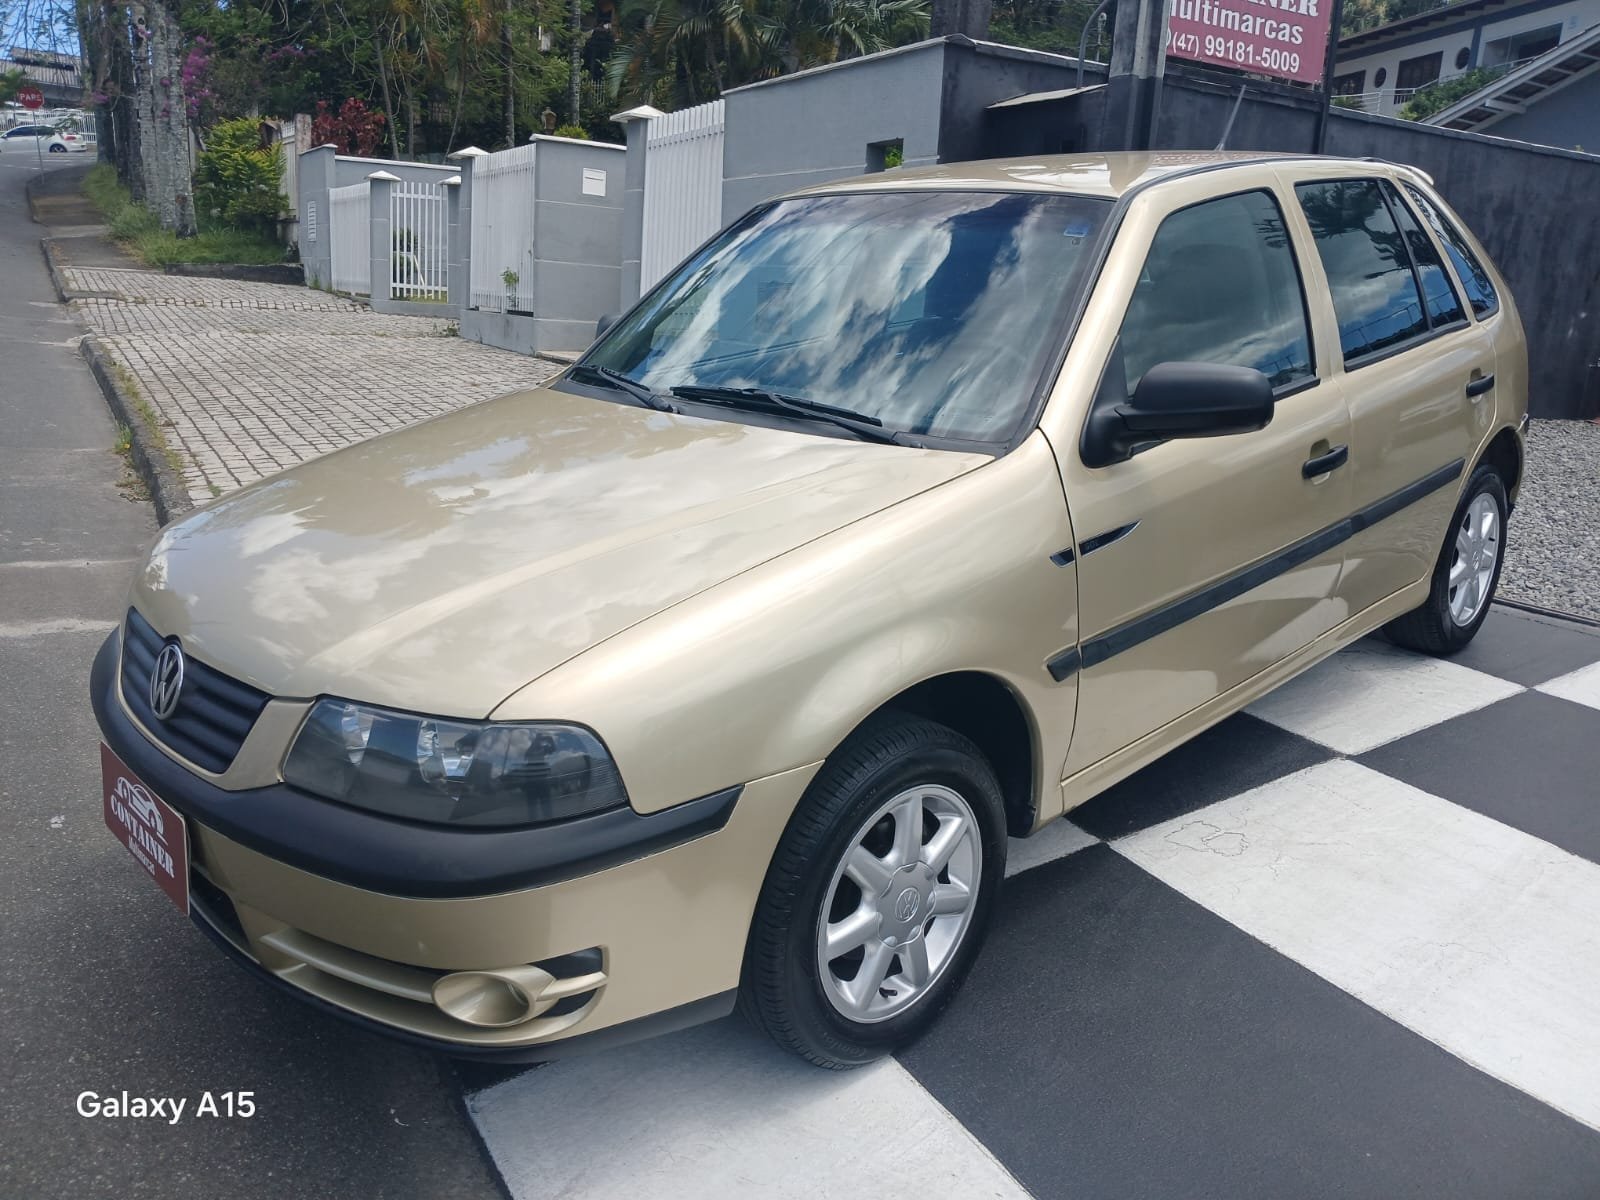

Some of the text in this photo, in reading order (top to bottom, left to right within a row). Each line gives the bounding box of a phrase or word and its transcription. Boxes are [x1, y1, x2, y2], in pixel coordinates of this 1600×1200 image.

[1172, 31, 1300, 73] (47) 99181-5009
[20, 93, 42, 102] PARE
[110, 794, 175, 879] CONTAINER
